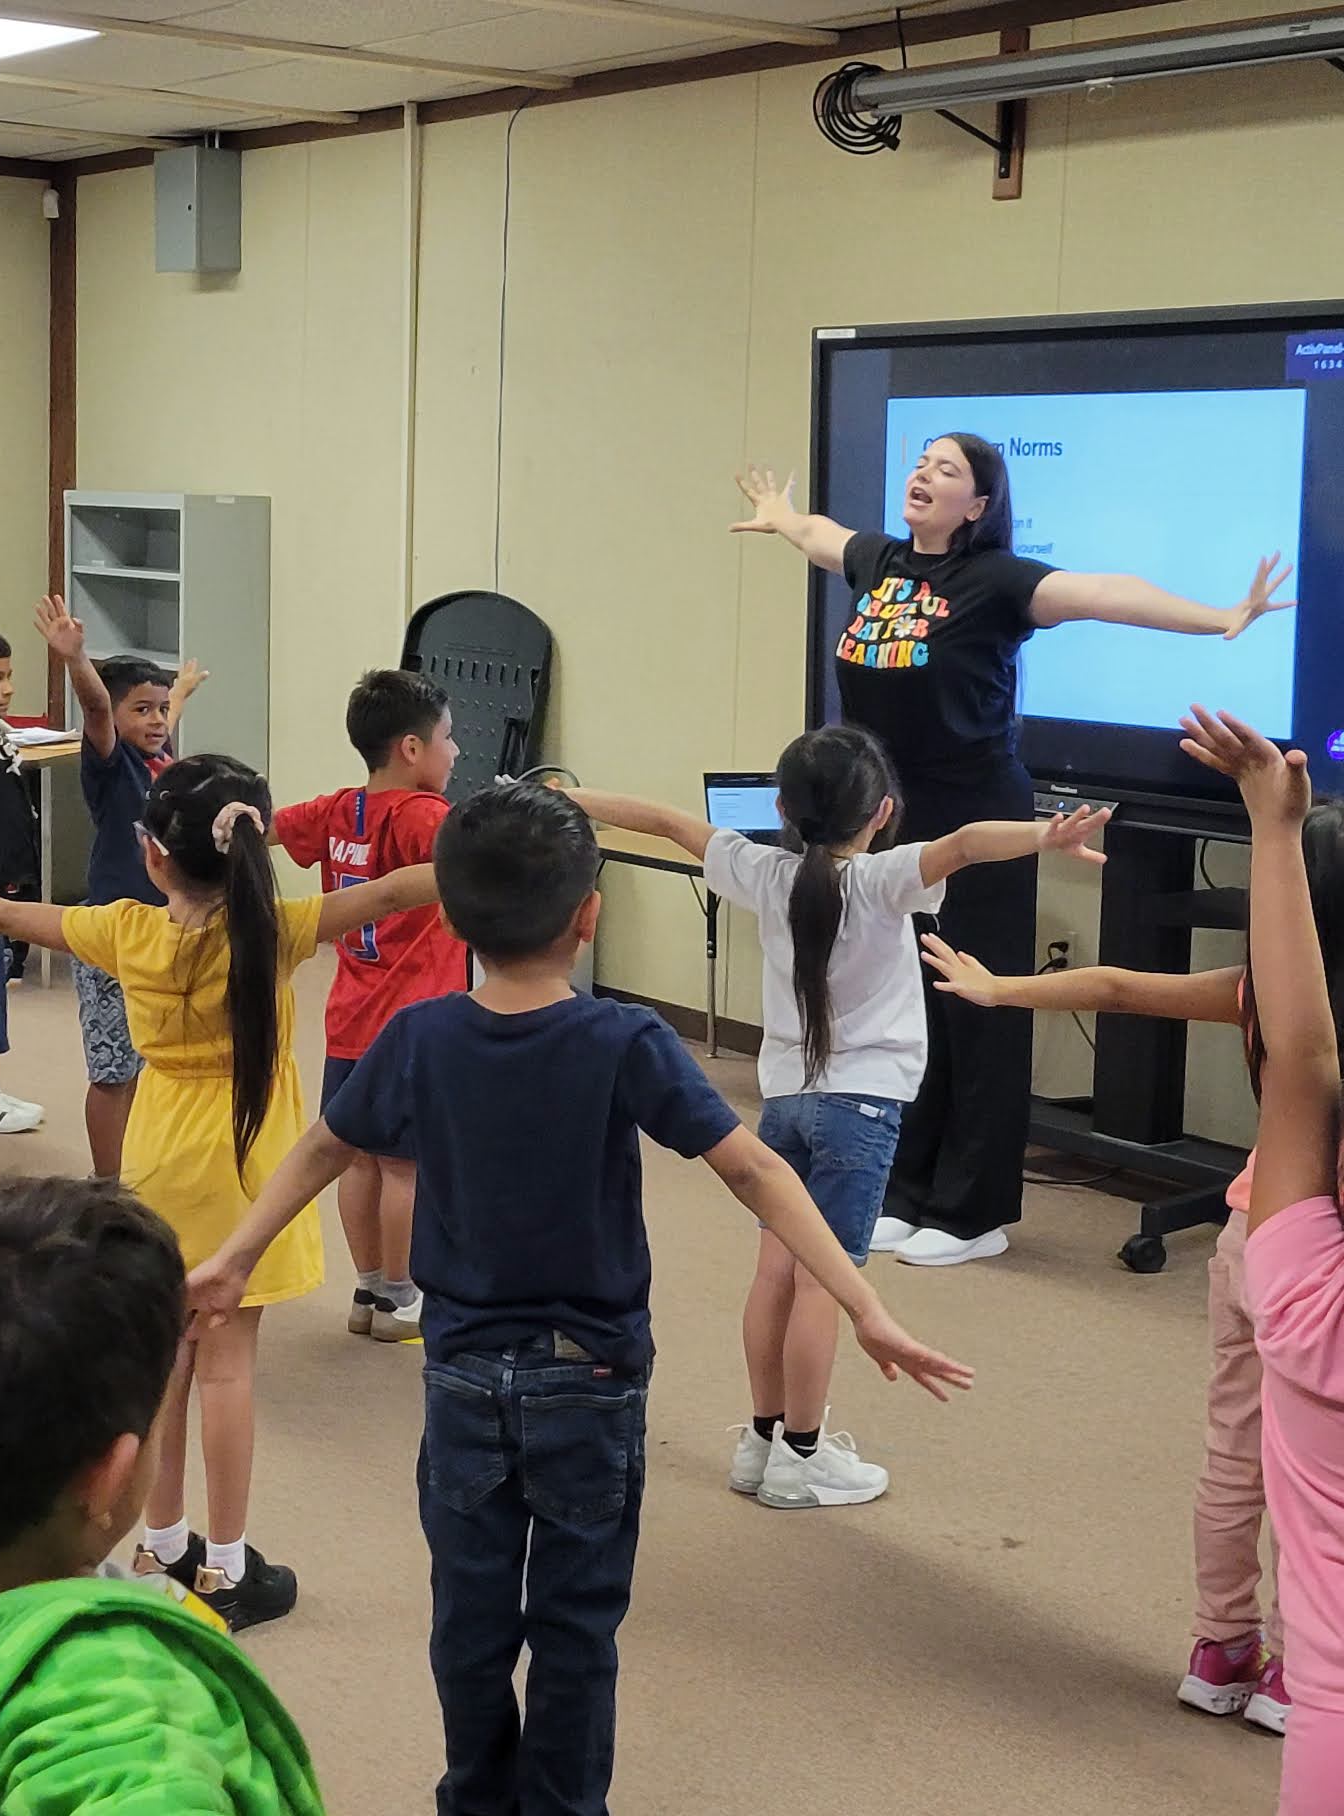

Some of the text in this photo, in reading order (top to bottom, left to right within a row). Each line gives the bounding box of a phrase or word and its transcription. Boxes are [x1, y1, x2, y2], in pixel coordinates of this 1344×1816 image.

[1009, 437, 1063, 457] Norms
[871, 577, 931, 603] IT'S A
[847, 615, 884, 641] DAY
[836, 632, 929, 669] LEARNING
